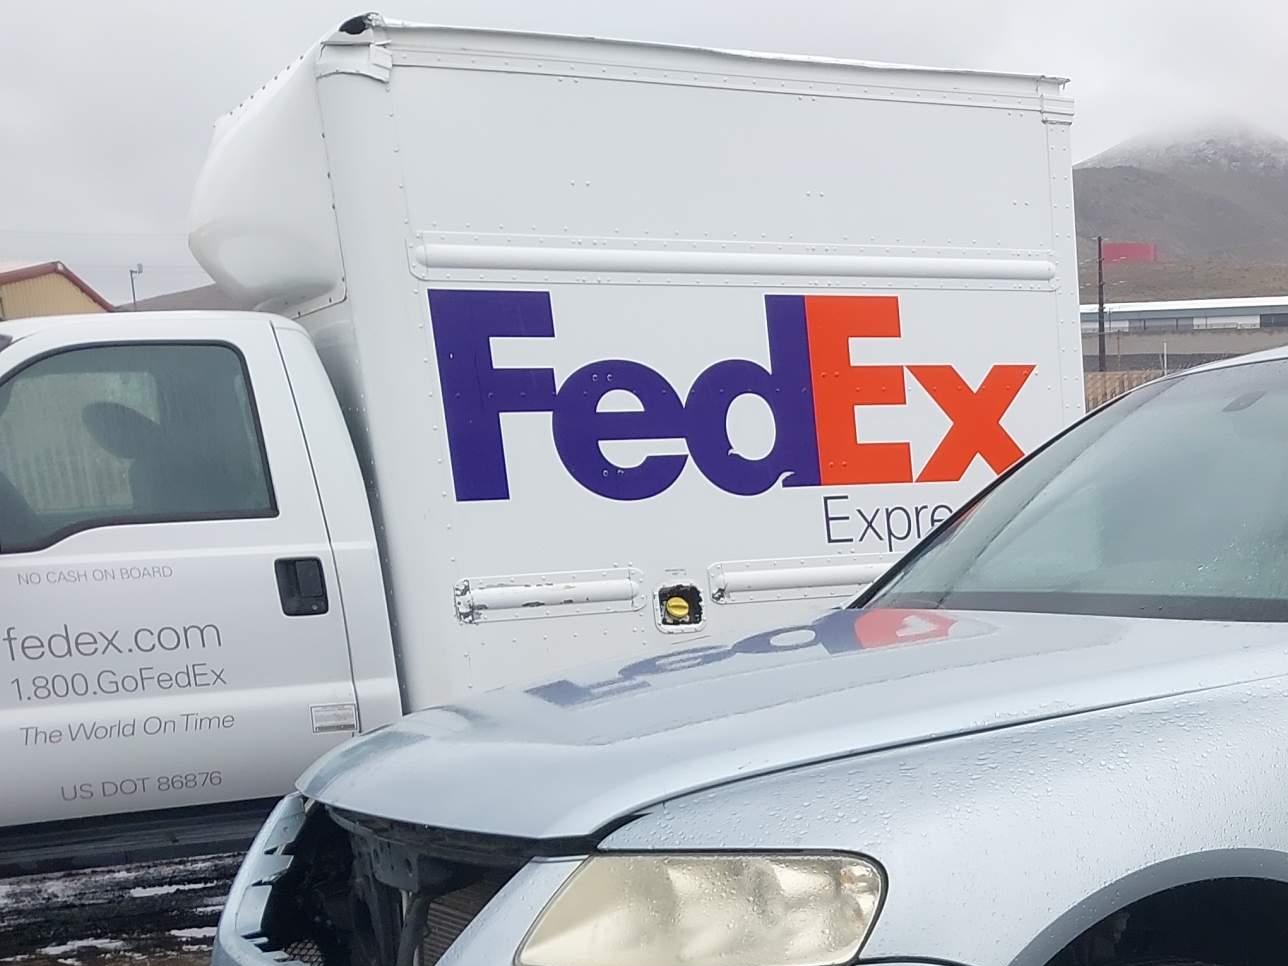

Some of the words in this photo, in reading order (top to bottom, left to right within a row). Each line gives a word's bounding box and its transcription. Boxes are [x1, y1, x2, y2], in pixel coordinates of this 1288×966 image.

[428, 289, 1036, 501] FedEx
[17, 572, 41, 586] NO
[46, 570, 88, 584] CASH
[92, 568, 115, 581] ON
[120, 565, 173, 580] BOARD
[2, 622, 223, 662] fedex.com
[10, 662, 228, 701] 1.800.GoFedEx
[20, 727, 63, 747] The
[68, 719, 136, 742] World
[144, 715, 177, 736] On
[181, 711, 236, 732] Time
[60, 783, 95, 802] US
[101, 777, 150, 798] DOT
[156, 770, 224, 792] 86876
